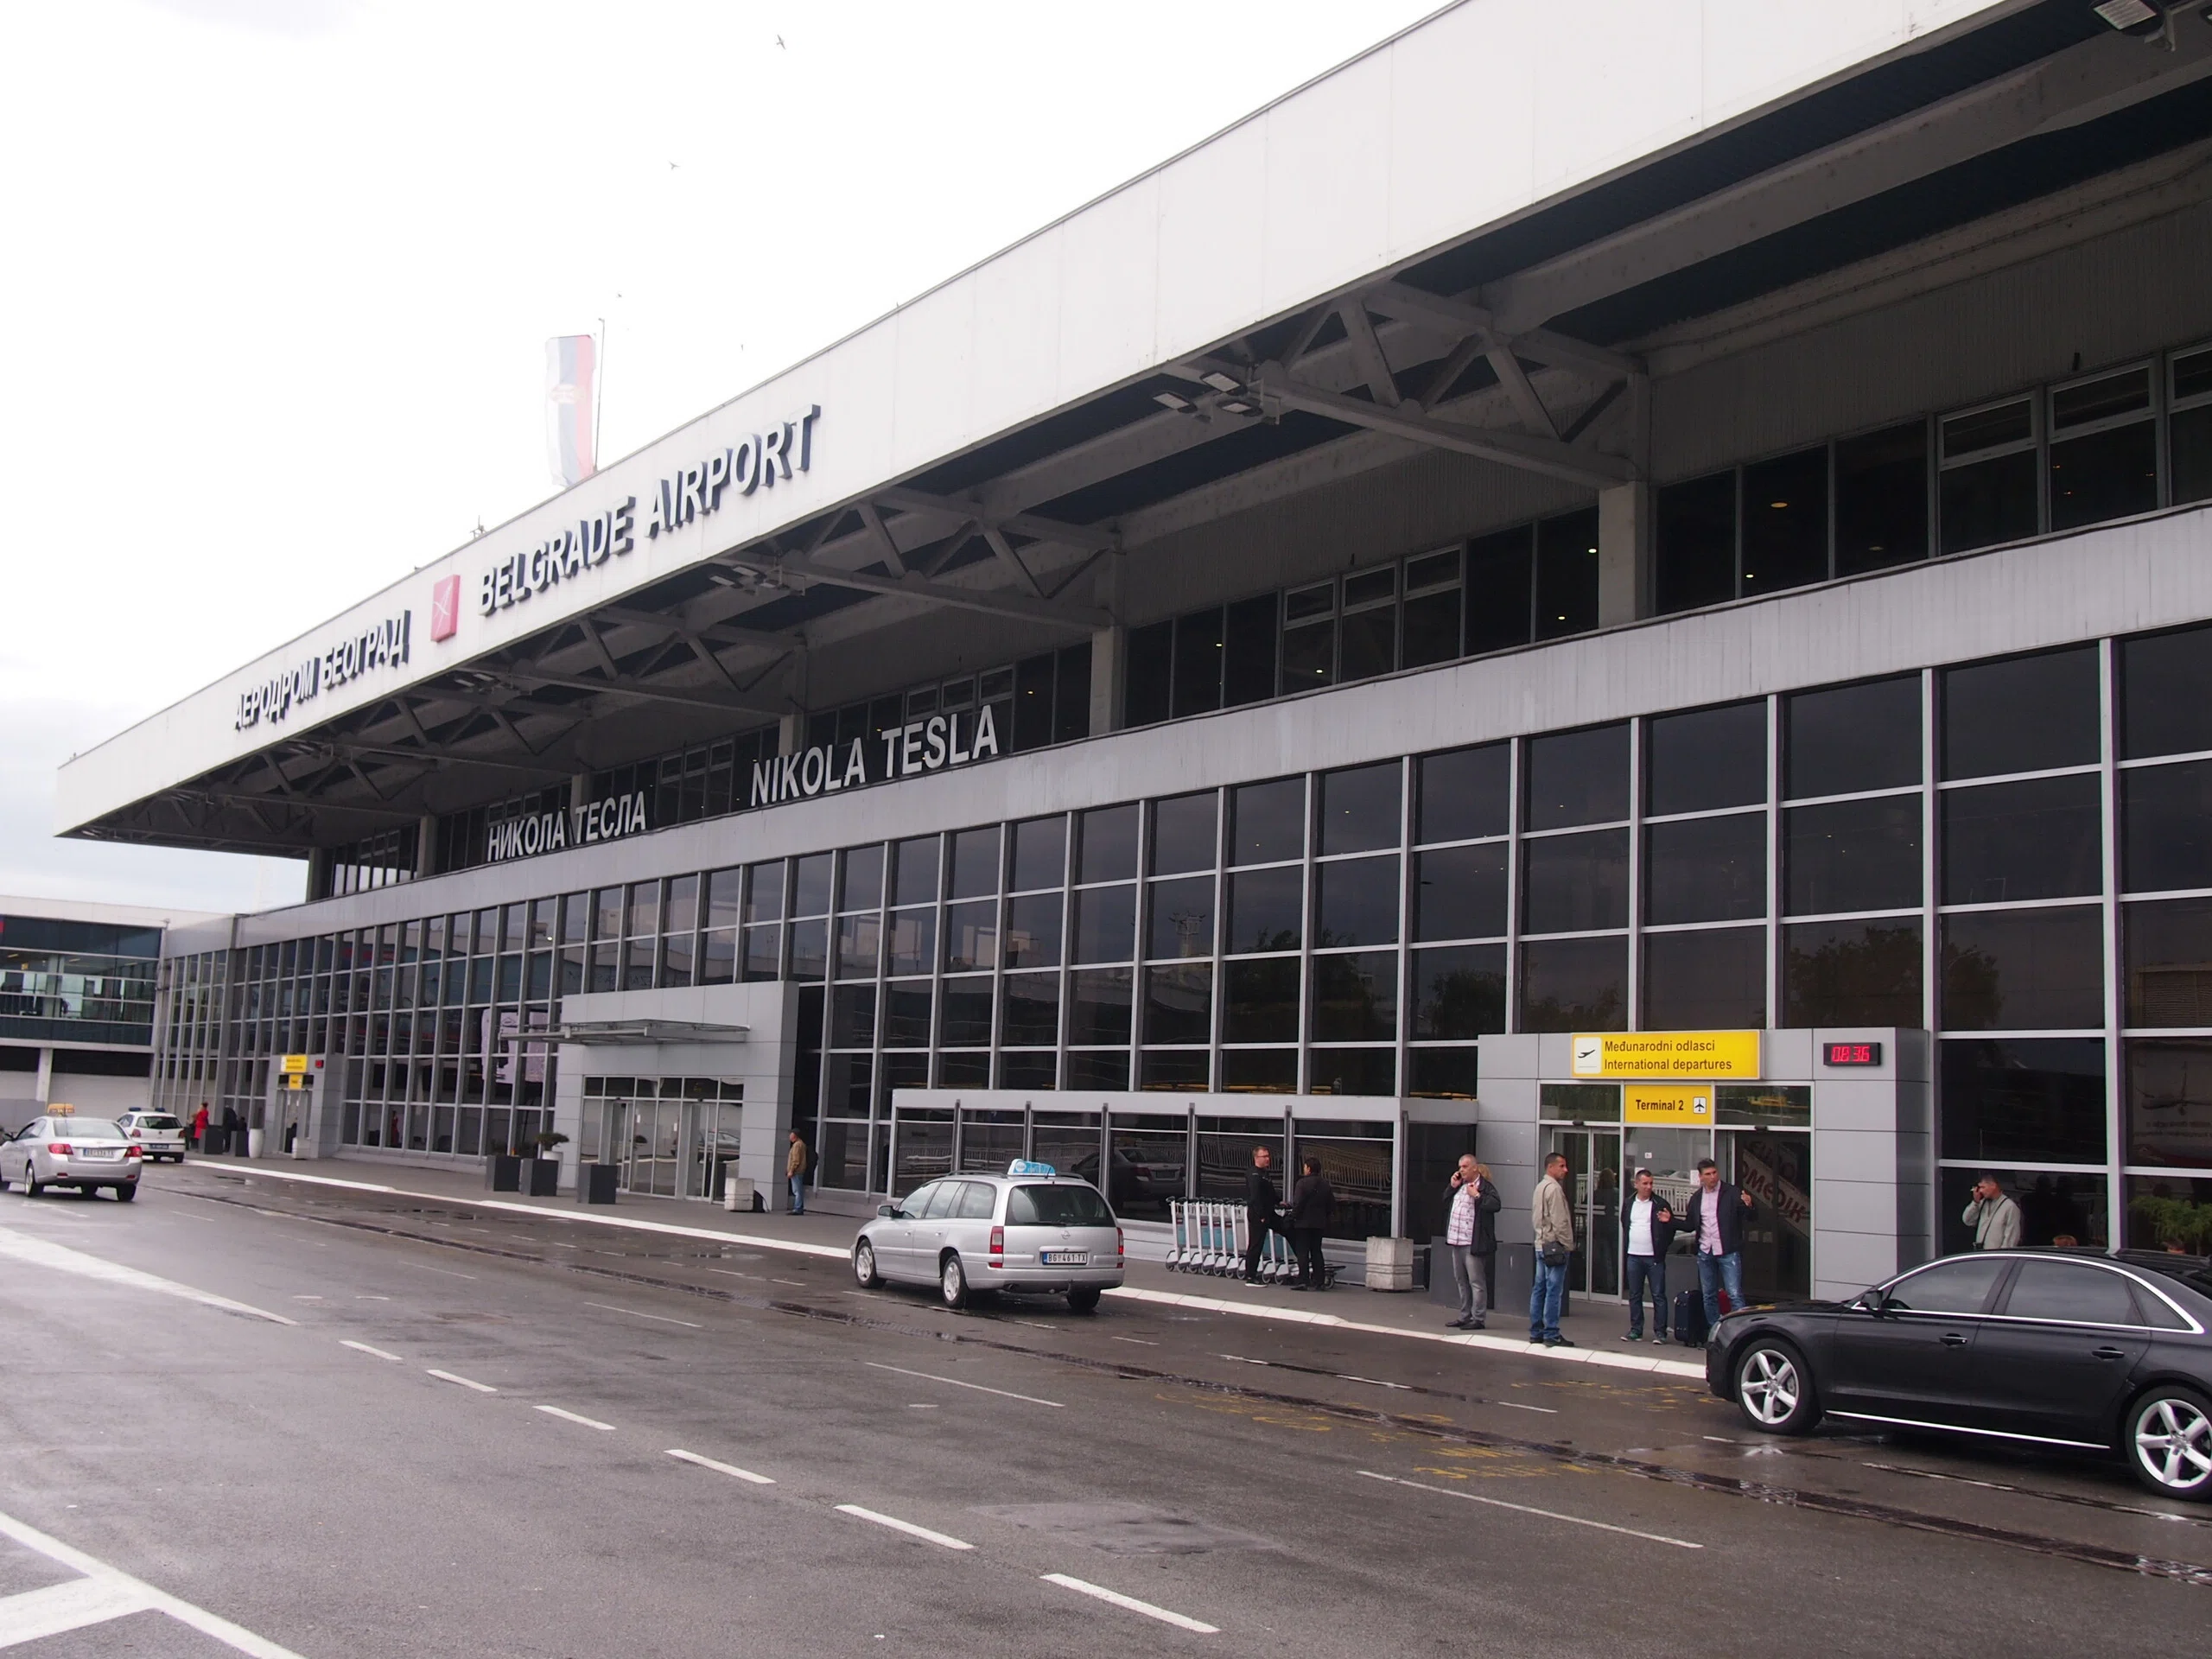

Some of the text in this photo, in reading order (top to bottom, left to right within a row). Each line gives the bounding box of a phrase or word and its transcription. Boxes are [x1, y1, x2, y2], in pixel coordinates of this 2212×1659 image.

[479, 404, 820, 616] BELGRADE AIRPORT
[235, 610, 411, 732] АЕРОДРОМ БЕОГРАД
[751, 705, 999, 807] NIKOLA TESLA
[487, 791, 646, 862] НИКОЛА ТЕСЛА
[1605, 1039, 1715, 1052] Međunarodni odlasci
[1605, 1058, 1732, 1071] International departures
[1636, 1099, 1684, 1110] Terminal 2
[1048, 1253, 1057, 1262] BG
